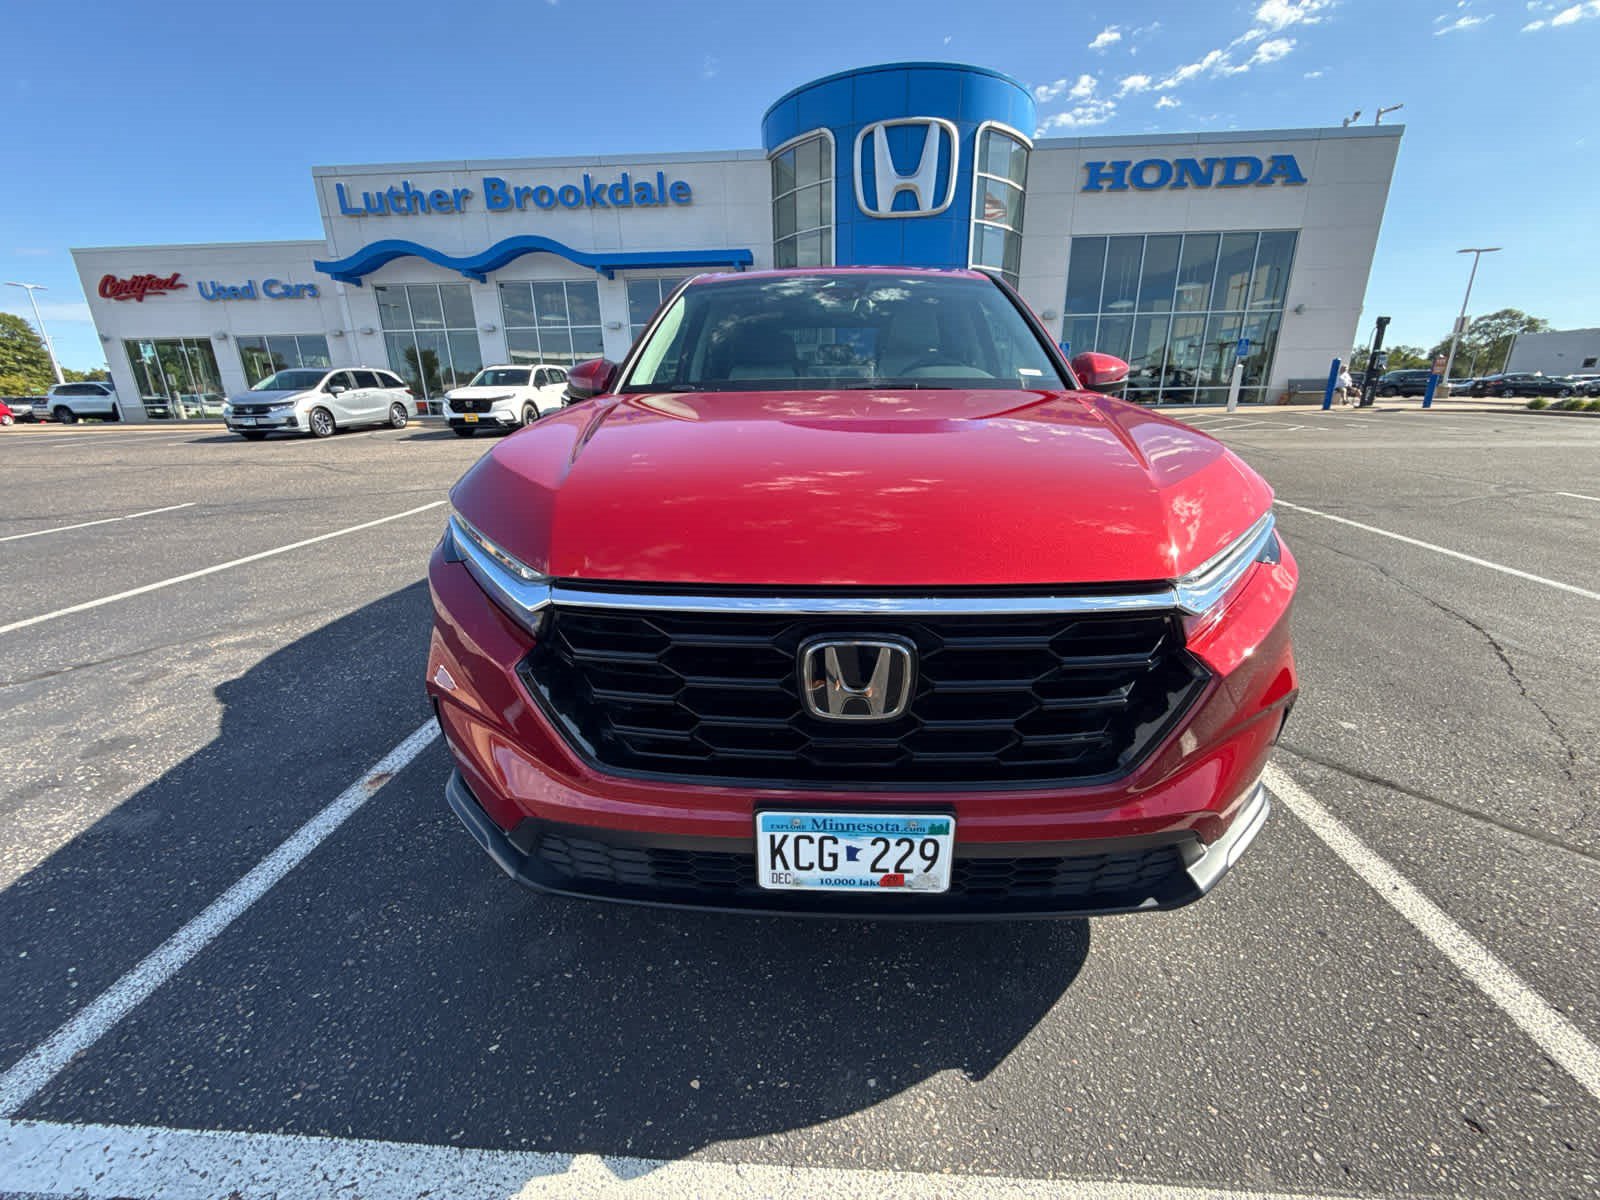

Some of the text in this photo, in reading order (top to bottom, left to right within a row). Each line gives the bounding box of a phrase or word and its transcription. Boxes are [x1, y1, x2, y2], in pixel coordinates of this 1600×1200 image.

[1081, 154, 1308, 192] HONDA
[335, 171, 692, 215] Luther Brookdale
[99, 273, 188, 302] Certified
[197, 278, 320, 301] Used Cars
[769, 834, 940, 874] KCG 229
[771, 872, 792, 885] DEC
[819, 877, 881, 887] 10,000 lak
